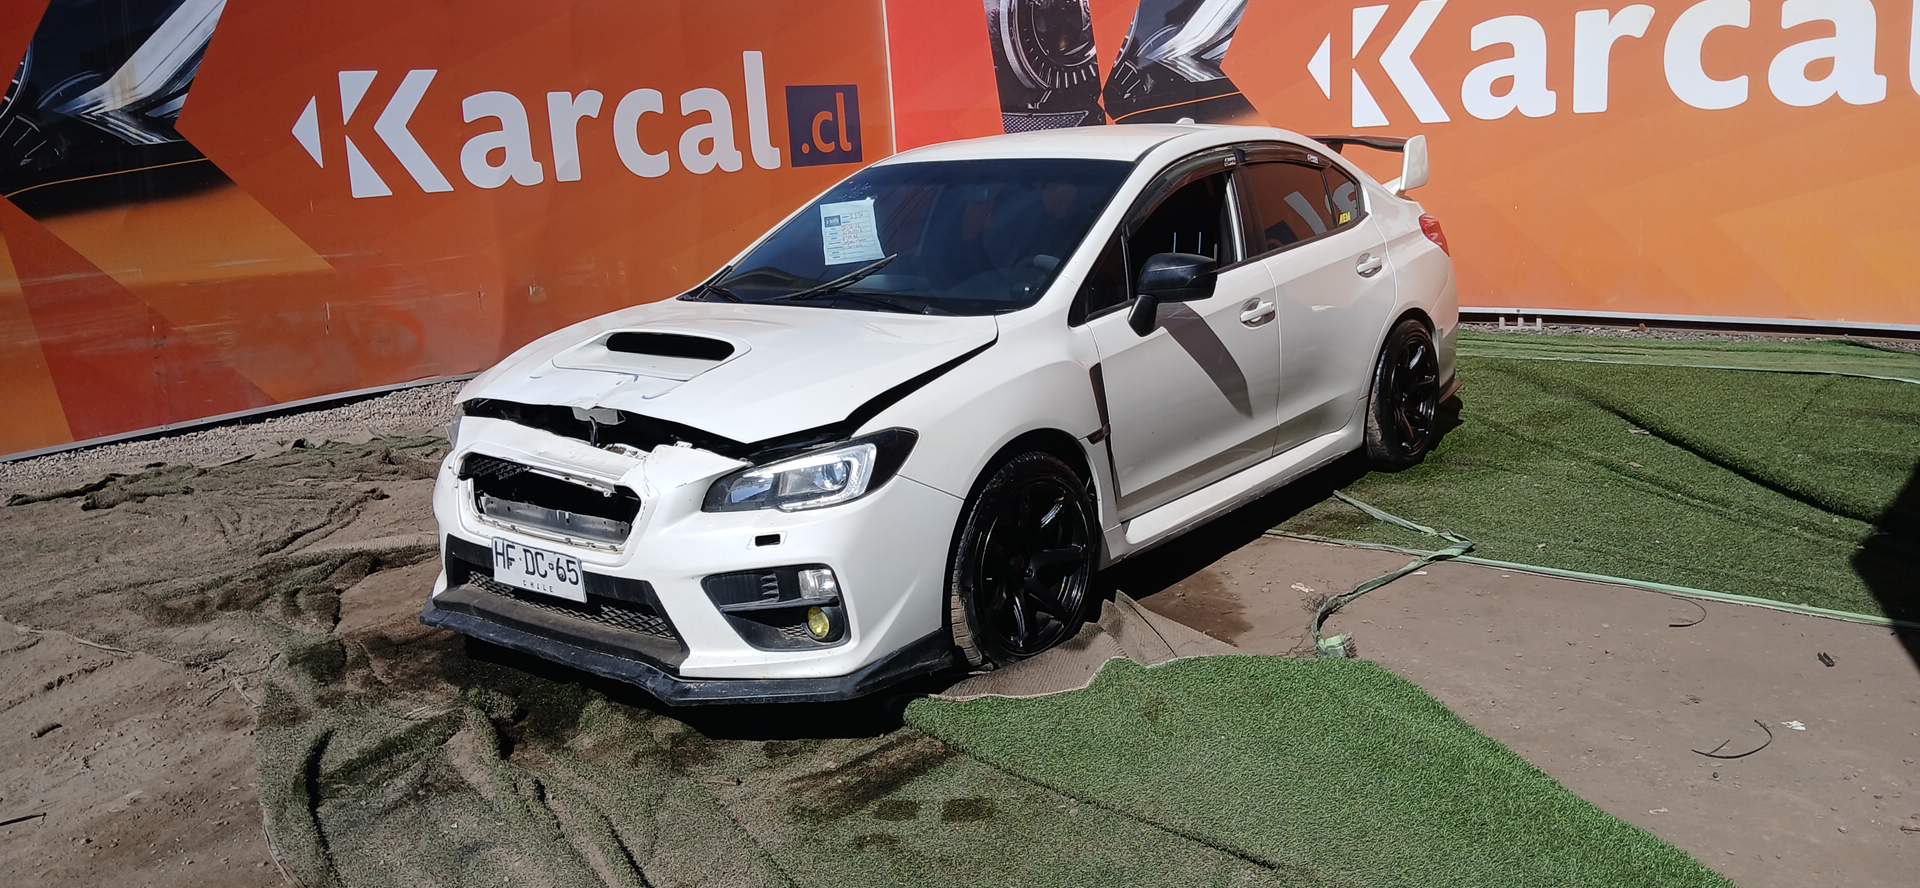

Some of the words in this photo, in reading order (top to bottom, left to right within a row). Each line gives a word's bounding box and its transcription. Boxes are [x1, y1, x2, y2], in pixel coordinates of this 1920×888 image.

[337, 50, 780, 198] Karcal
[801, 92, 852, 154] .cl
[1350, 0, 1920, 127] Karca
